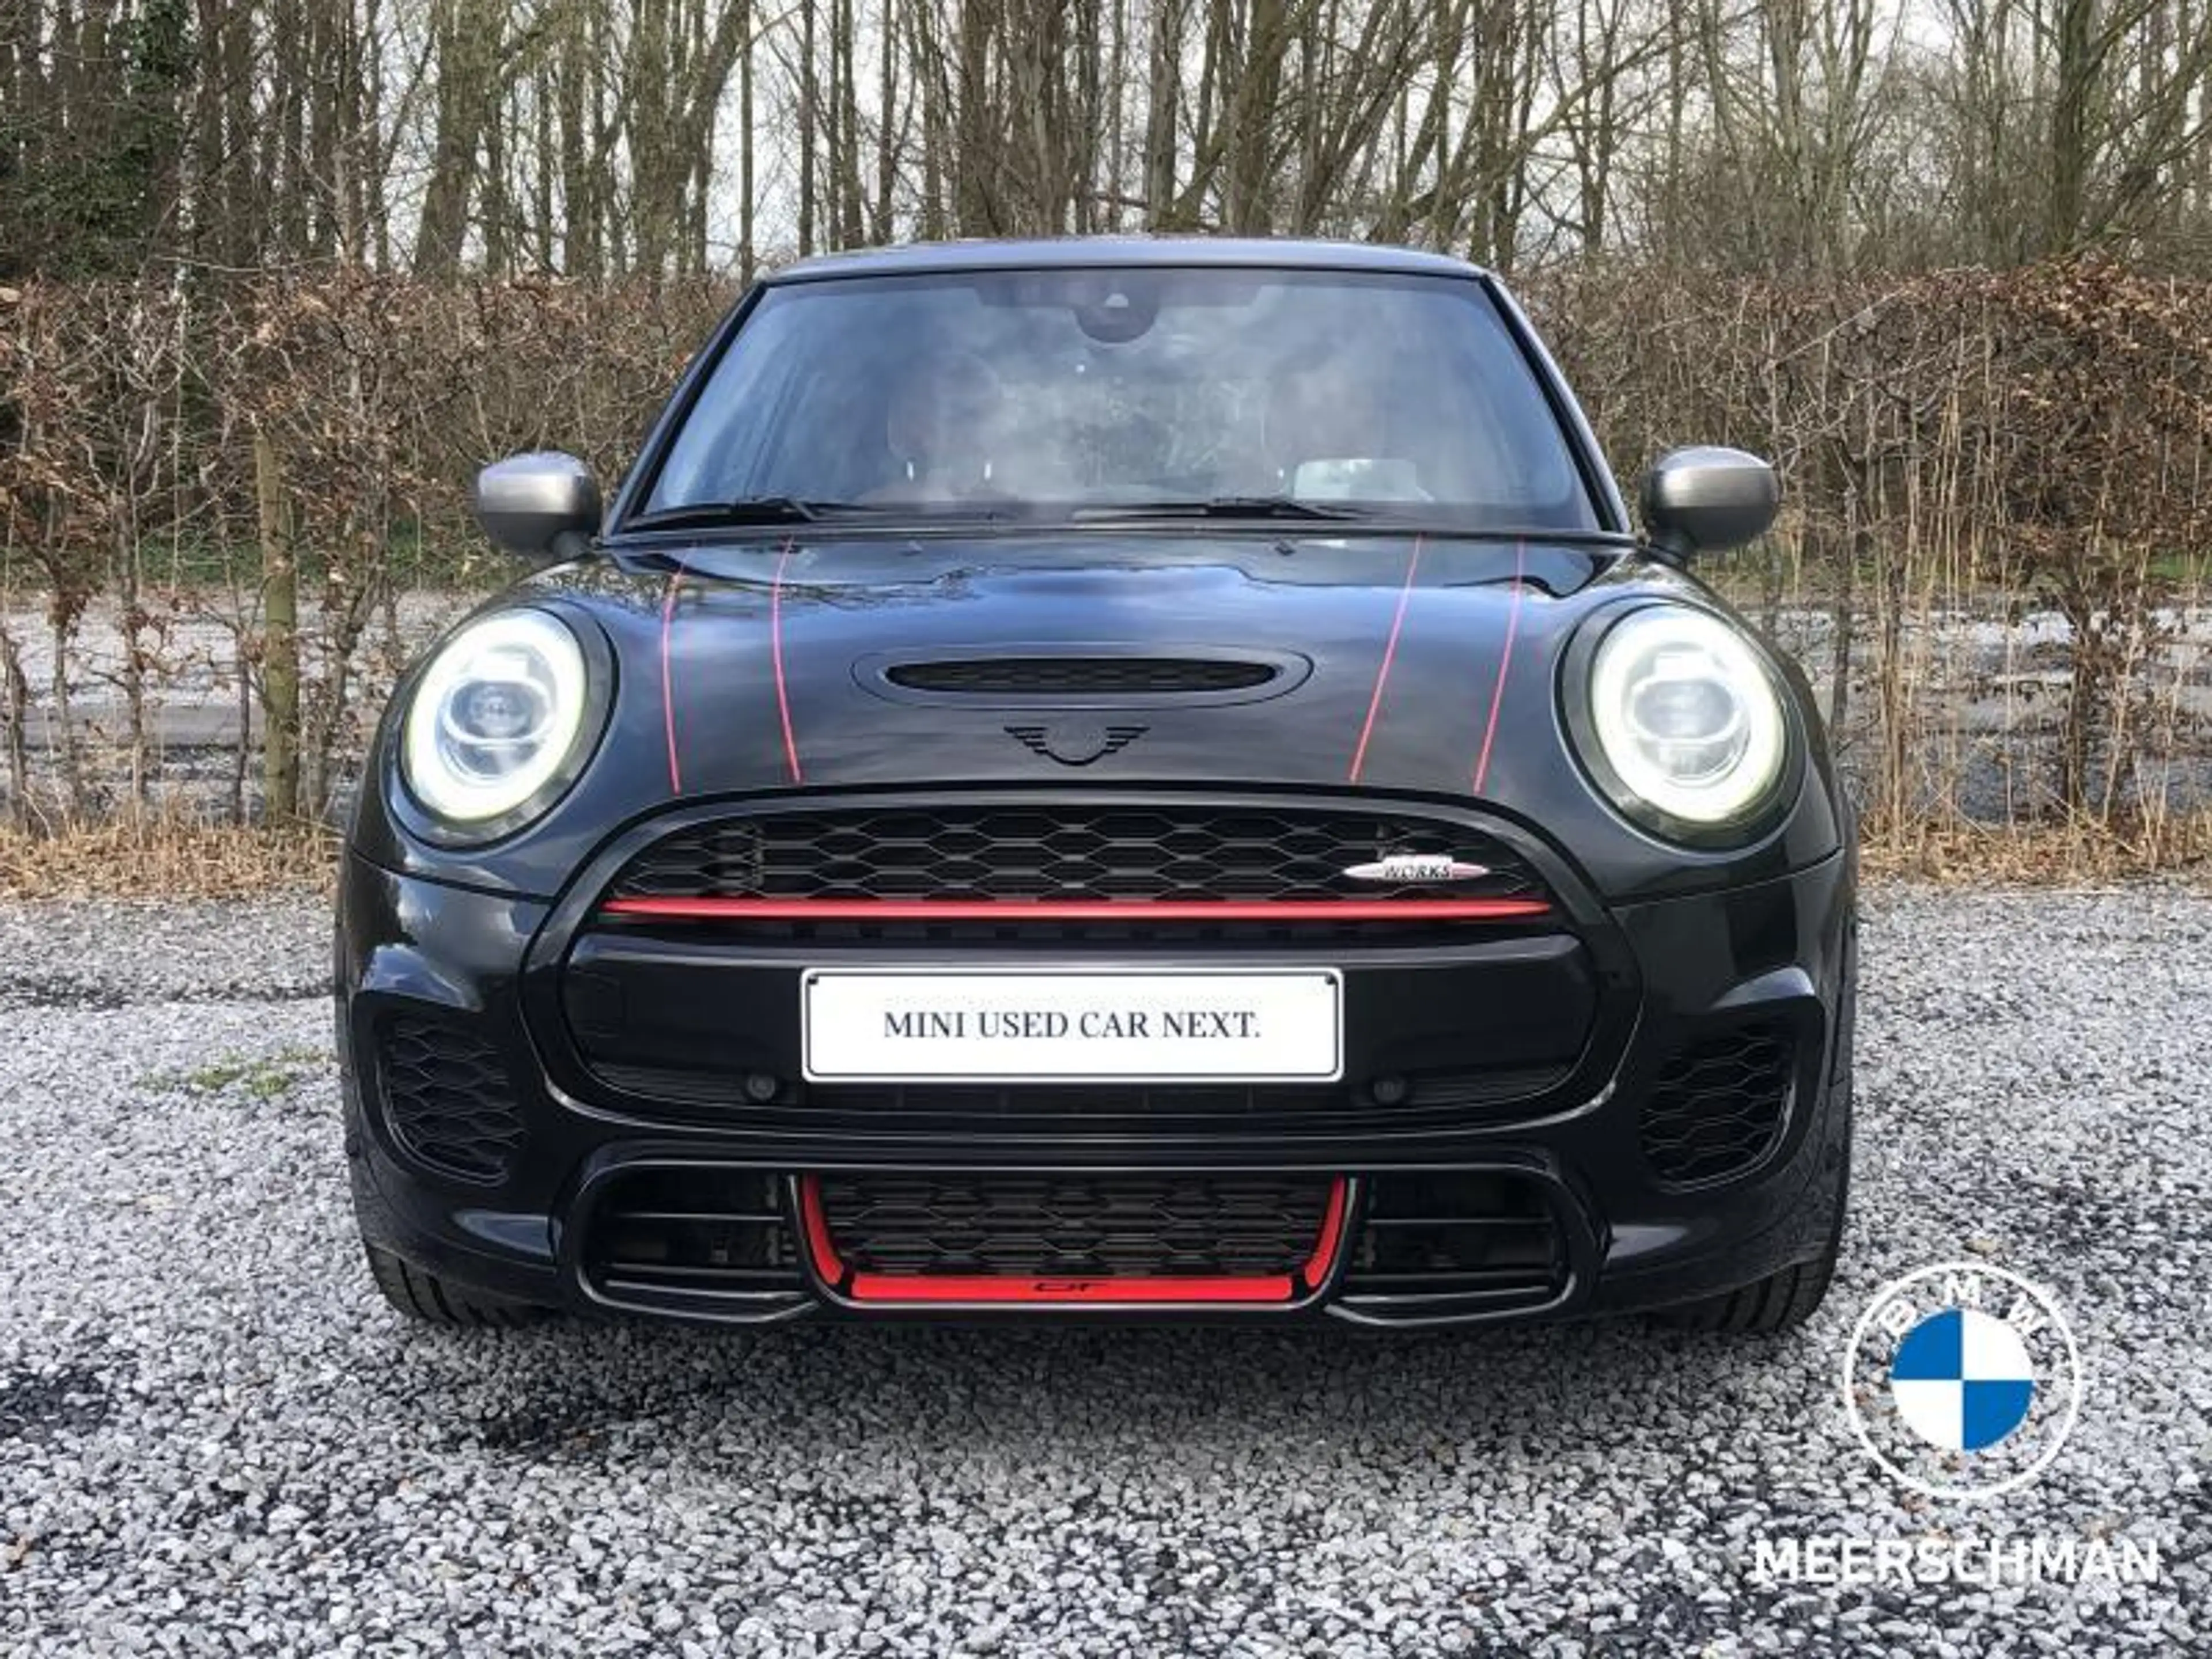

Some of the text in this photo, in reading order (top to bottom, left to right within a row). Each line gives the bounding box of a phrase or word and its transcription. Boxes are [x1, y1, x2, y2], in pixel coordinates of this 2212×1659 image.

[1384, 864, 1450, 878] WORKS
[884, 1011, 1260, 1038] MINI USED CAR NEXT.
